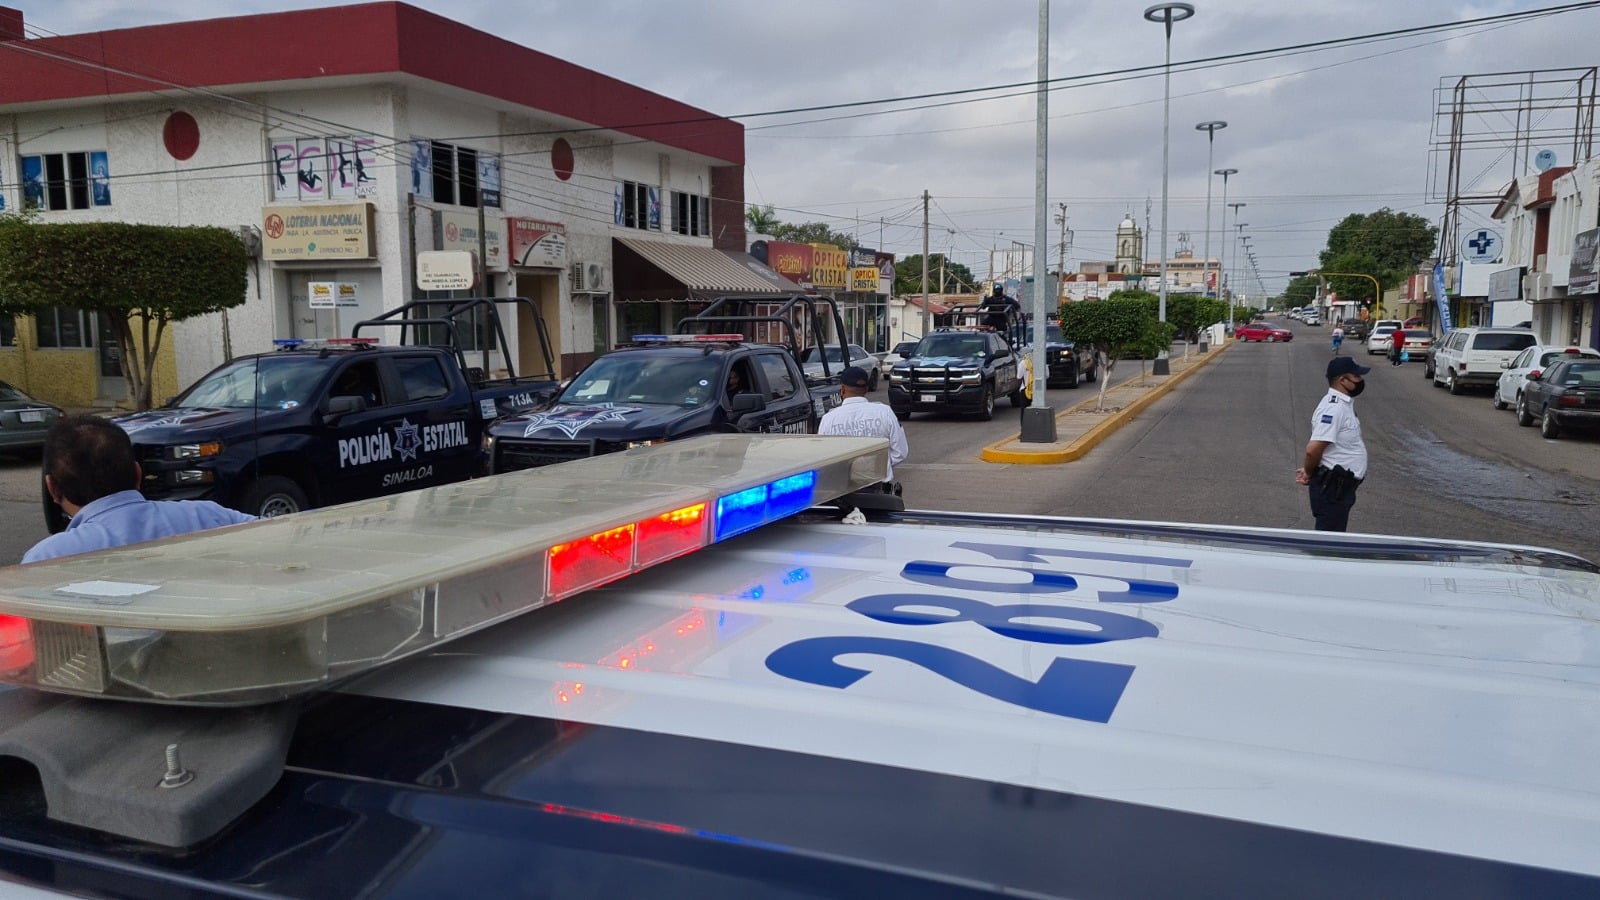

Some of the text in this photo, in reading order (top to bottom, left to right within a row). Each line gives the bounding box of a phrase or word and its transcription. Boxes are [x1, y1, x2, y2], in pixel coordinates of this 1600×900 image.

[286, 213, 362, 228] LOTERIA NACIONAL
[516, 220, 546, 231] NOTARIA
[814, 251, 847, 268] OPTICA
[814, 268, 847, 285] CRISTAL
[855, 269, 876, 279] OPTICA
[853, 279, 878, 289] CRISTAL
[508, 392, 534, 407] 713A
[831, 418, 882, 434] TRANSITO
[338, 420, 469, 468] POLICÍA ESTATAL
[381, 464, 434, 488] SINALOA
[765, 541, 1194, 725] 2891
